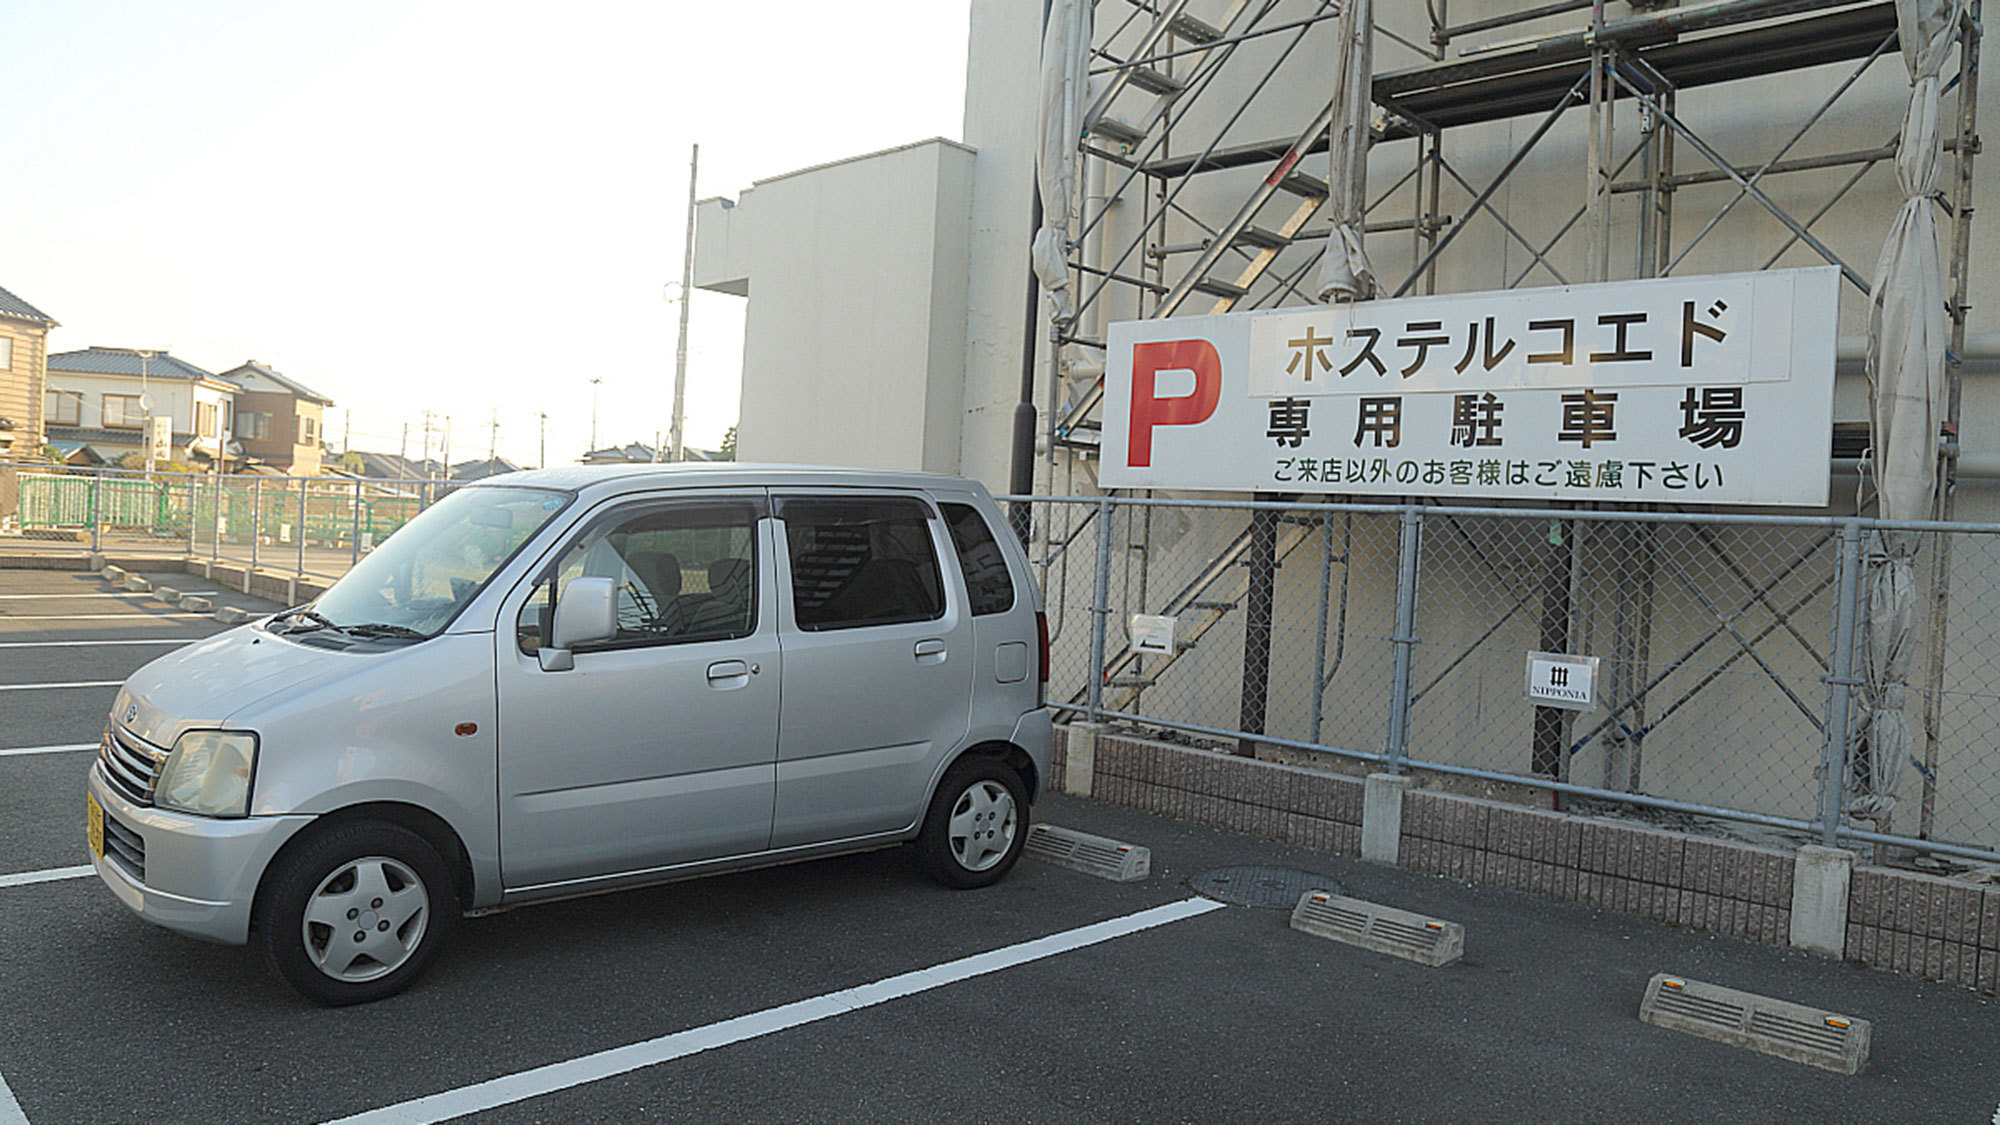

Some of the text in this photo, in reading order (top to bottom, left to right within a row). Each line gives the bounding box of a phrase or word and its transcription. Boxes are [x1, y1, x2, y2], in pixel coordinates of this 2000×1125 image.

[1286, 300, 1728, 382] ホステルコエド
[1127, 338, 1221, 469] P
[1266, 387, 1745, 449] 専用駐車場
[1274, 457, 1724, 490] ご来店以外のお客様はご遠慮下さい
[1533, 686, 1587, 699] NIPPONIA
